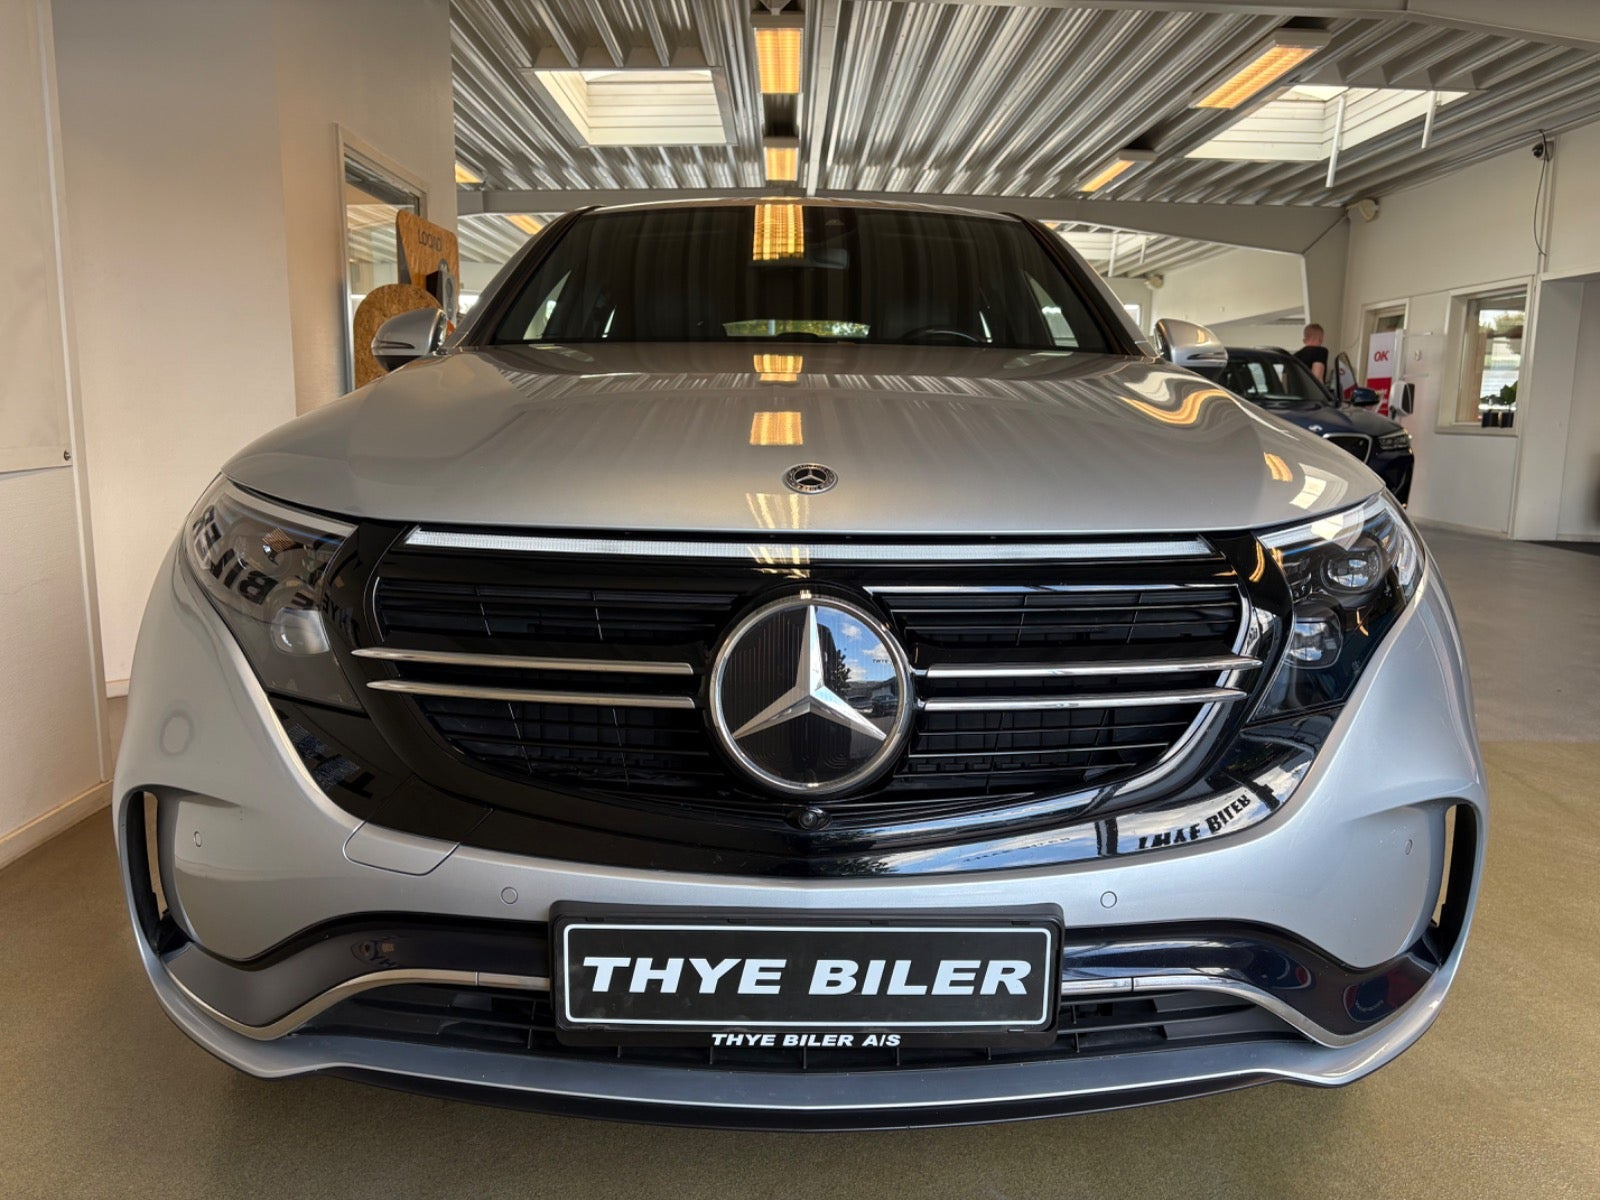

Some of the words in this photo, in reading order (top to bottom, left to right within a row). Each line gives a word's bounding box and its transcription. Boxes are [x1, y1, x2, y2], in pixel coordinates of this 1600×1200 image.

[1374, 350, 1389, 362] OK
[583, 957, 787, 994] THYE
[808, 960, 1032, 995] BILER
[711, 1033, 776, 1047] THYE
[782, 1033, 853, 1047] BILER
[862, 1033, 901, 1047] A/S
